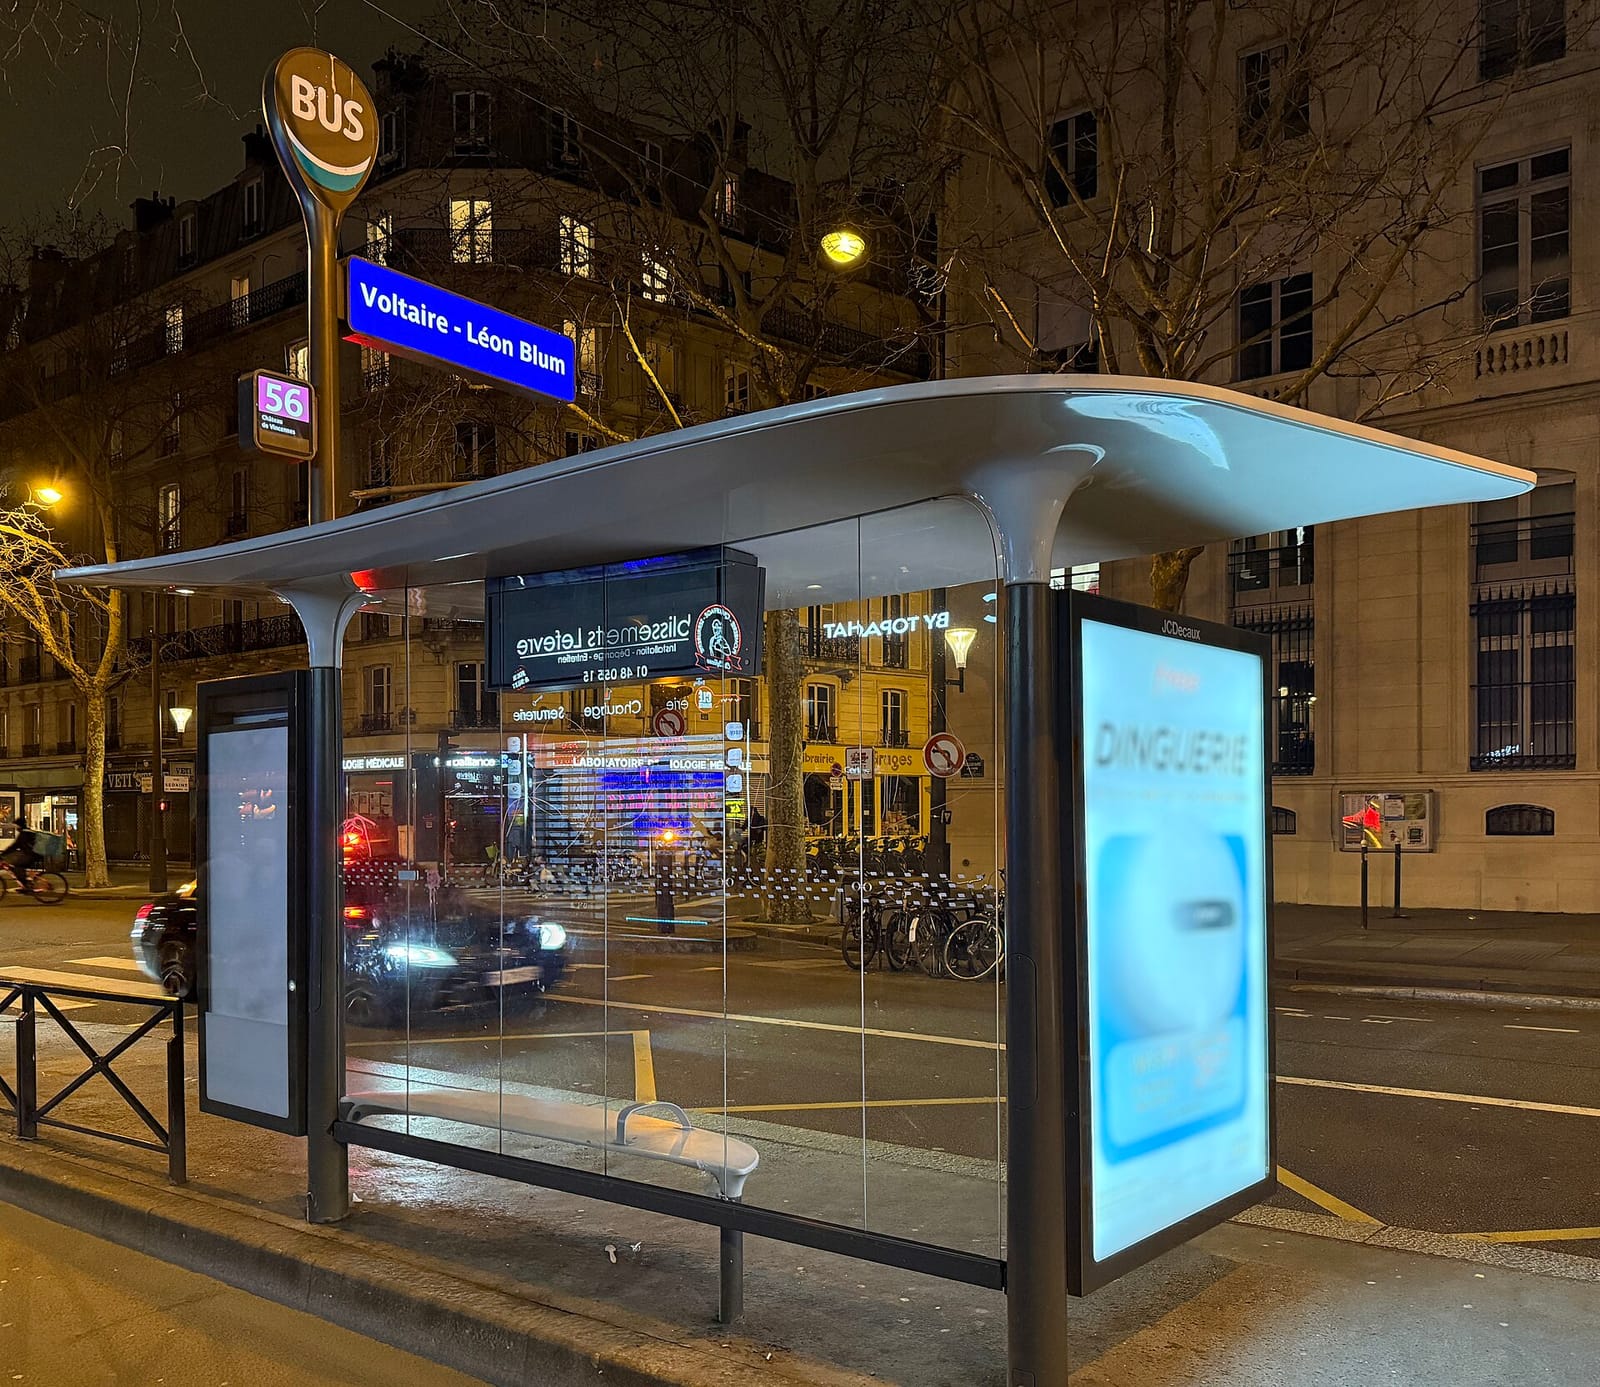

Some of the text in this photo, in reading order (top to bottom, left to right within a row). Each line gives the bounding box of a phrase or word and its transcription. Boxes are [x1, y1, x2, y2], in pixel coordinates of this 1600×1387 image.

[291, 74, 364, 142] BUS
[360, 281, 449, 334] Voltaire
[466, 320, 513, 358] Léon
[519, 339, 566, 377] Blum
[265, 382, 304, 418] 56
[1161, 619, 1201, 641] JCDecaux
[801, 751, 835, 764] ibrairie
[1095, 722, 1249, 777] DINGUERIE
[366, 757, 404, 770] MÉDICALE
[669, 758, 707, 770] IOLOGIE
[107, 773, 132, 788] VETI
